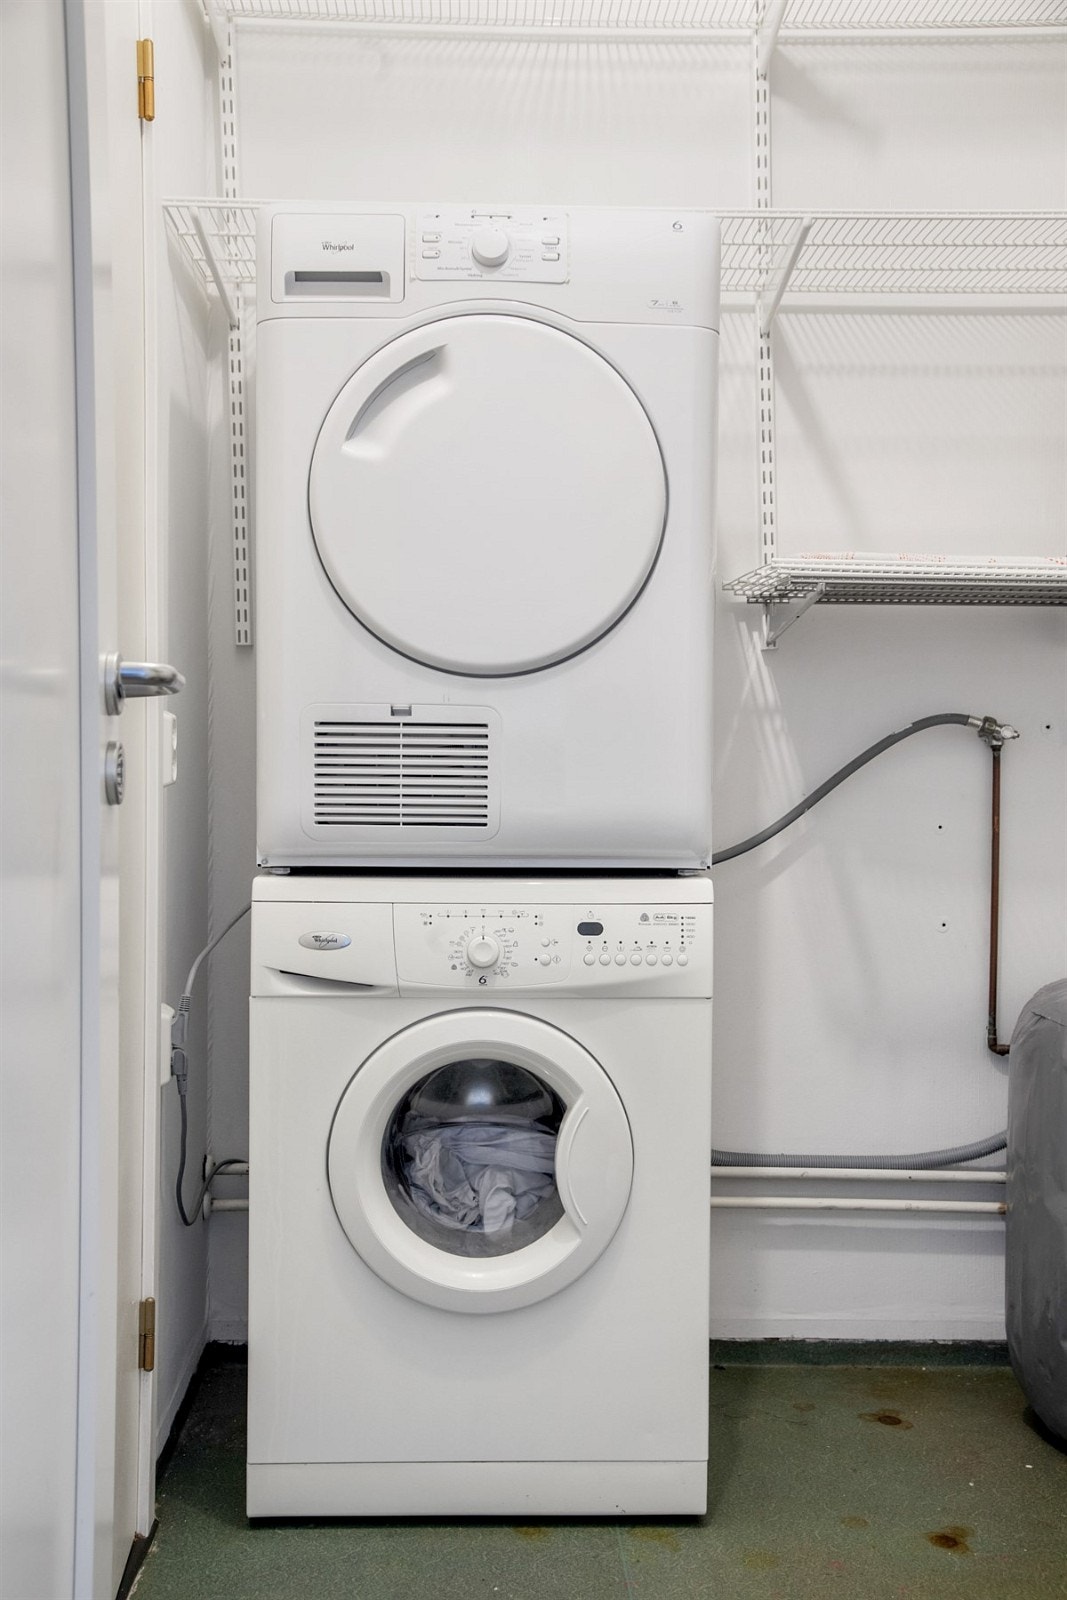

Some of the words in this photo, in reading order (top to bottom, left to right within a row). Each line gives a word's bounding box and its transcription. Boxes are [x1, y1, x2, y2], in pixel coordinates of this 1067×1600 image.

[672, 220, 682, 230] 6
[322, 244, 354, 252] Whirlpool
[478, 975, 487, 984] 6
